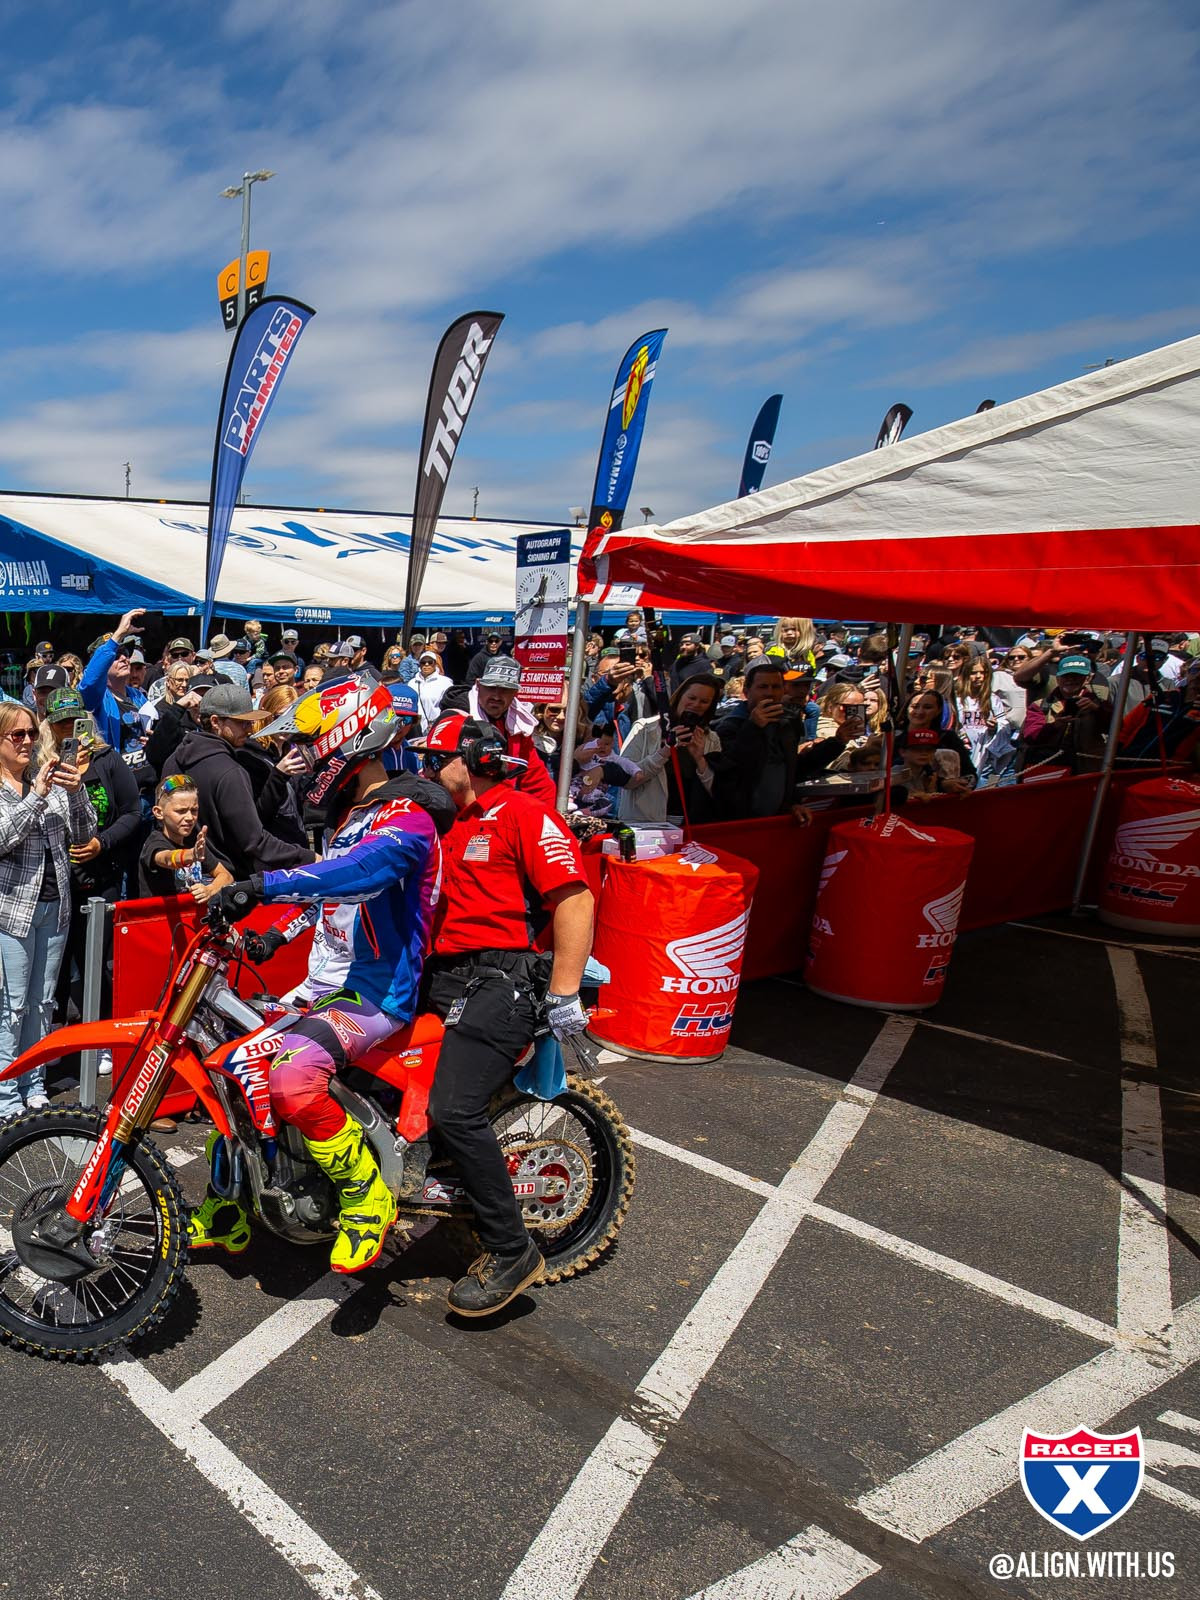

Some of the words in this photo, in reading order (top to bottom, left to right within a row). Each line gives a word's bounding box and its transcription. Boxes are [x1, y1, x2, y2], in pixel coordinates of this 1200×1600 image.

[249, 261, 260, 282] C
[225, 273, 236, 293] C
[225, 300, 235, 321] 5
[224, 306, 295, 449] PARTS
[240, 317, 302, 457] UNLIMITED
[424, 322, 494, 483] THOR
[607, 450, 625, 503] YAMAHA
[526, 537, 561, 550] AUTOGRAPH
[527, 552, 550, 563] SIGNING
[550, 551, 558, 561] AT
[5, 560, 51, 586] YAMAHA
[303, 608, 331, 620] YAMAHA
[46, 669, 57, 680] 1
[488, 667, 510, 675] FOX
[526, 673, 547, 683] STARTS
[548, 673, 563, 683] HERE
[393, 696, 413, 704] NDA
[319, 699, 378, 756] 100%
[287, 904, 319, 933] HON
[660, 973, 741, 995] HOND
[243, 1035, 285, 1058] HON
[124, 1050, 161, 1118] SHOWA
[73, 1128, 110, 1203] DUNLOP
